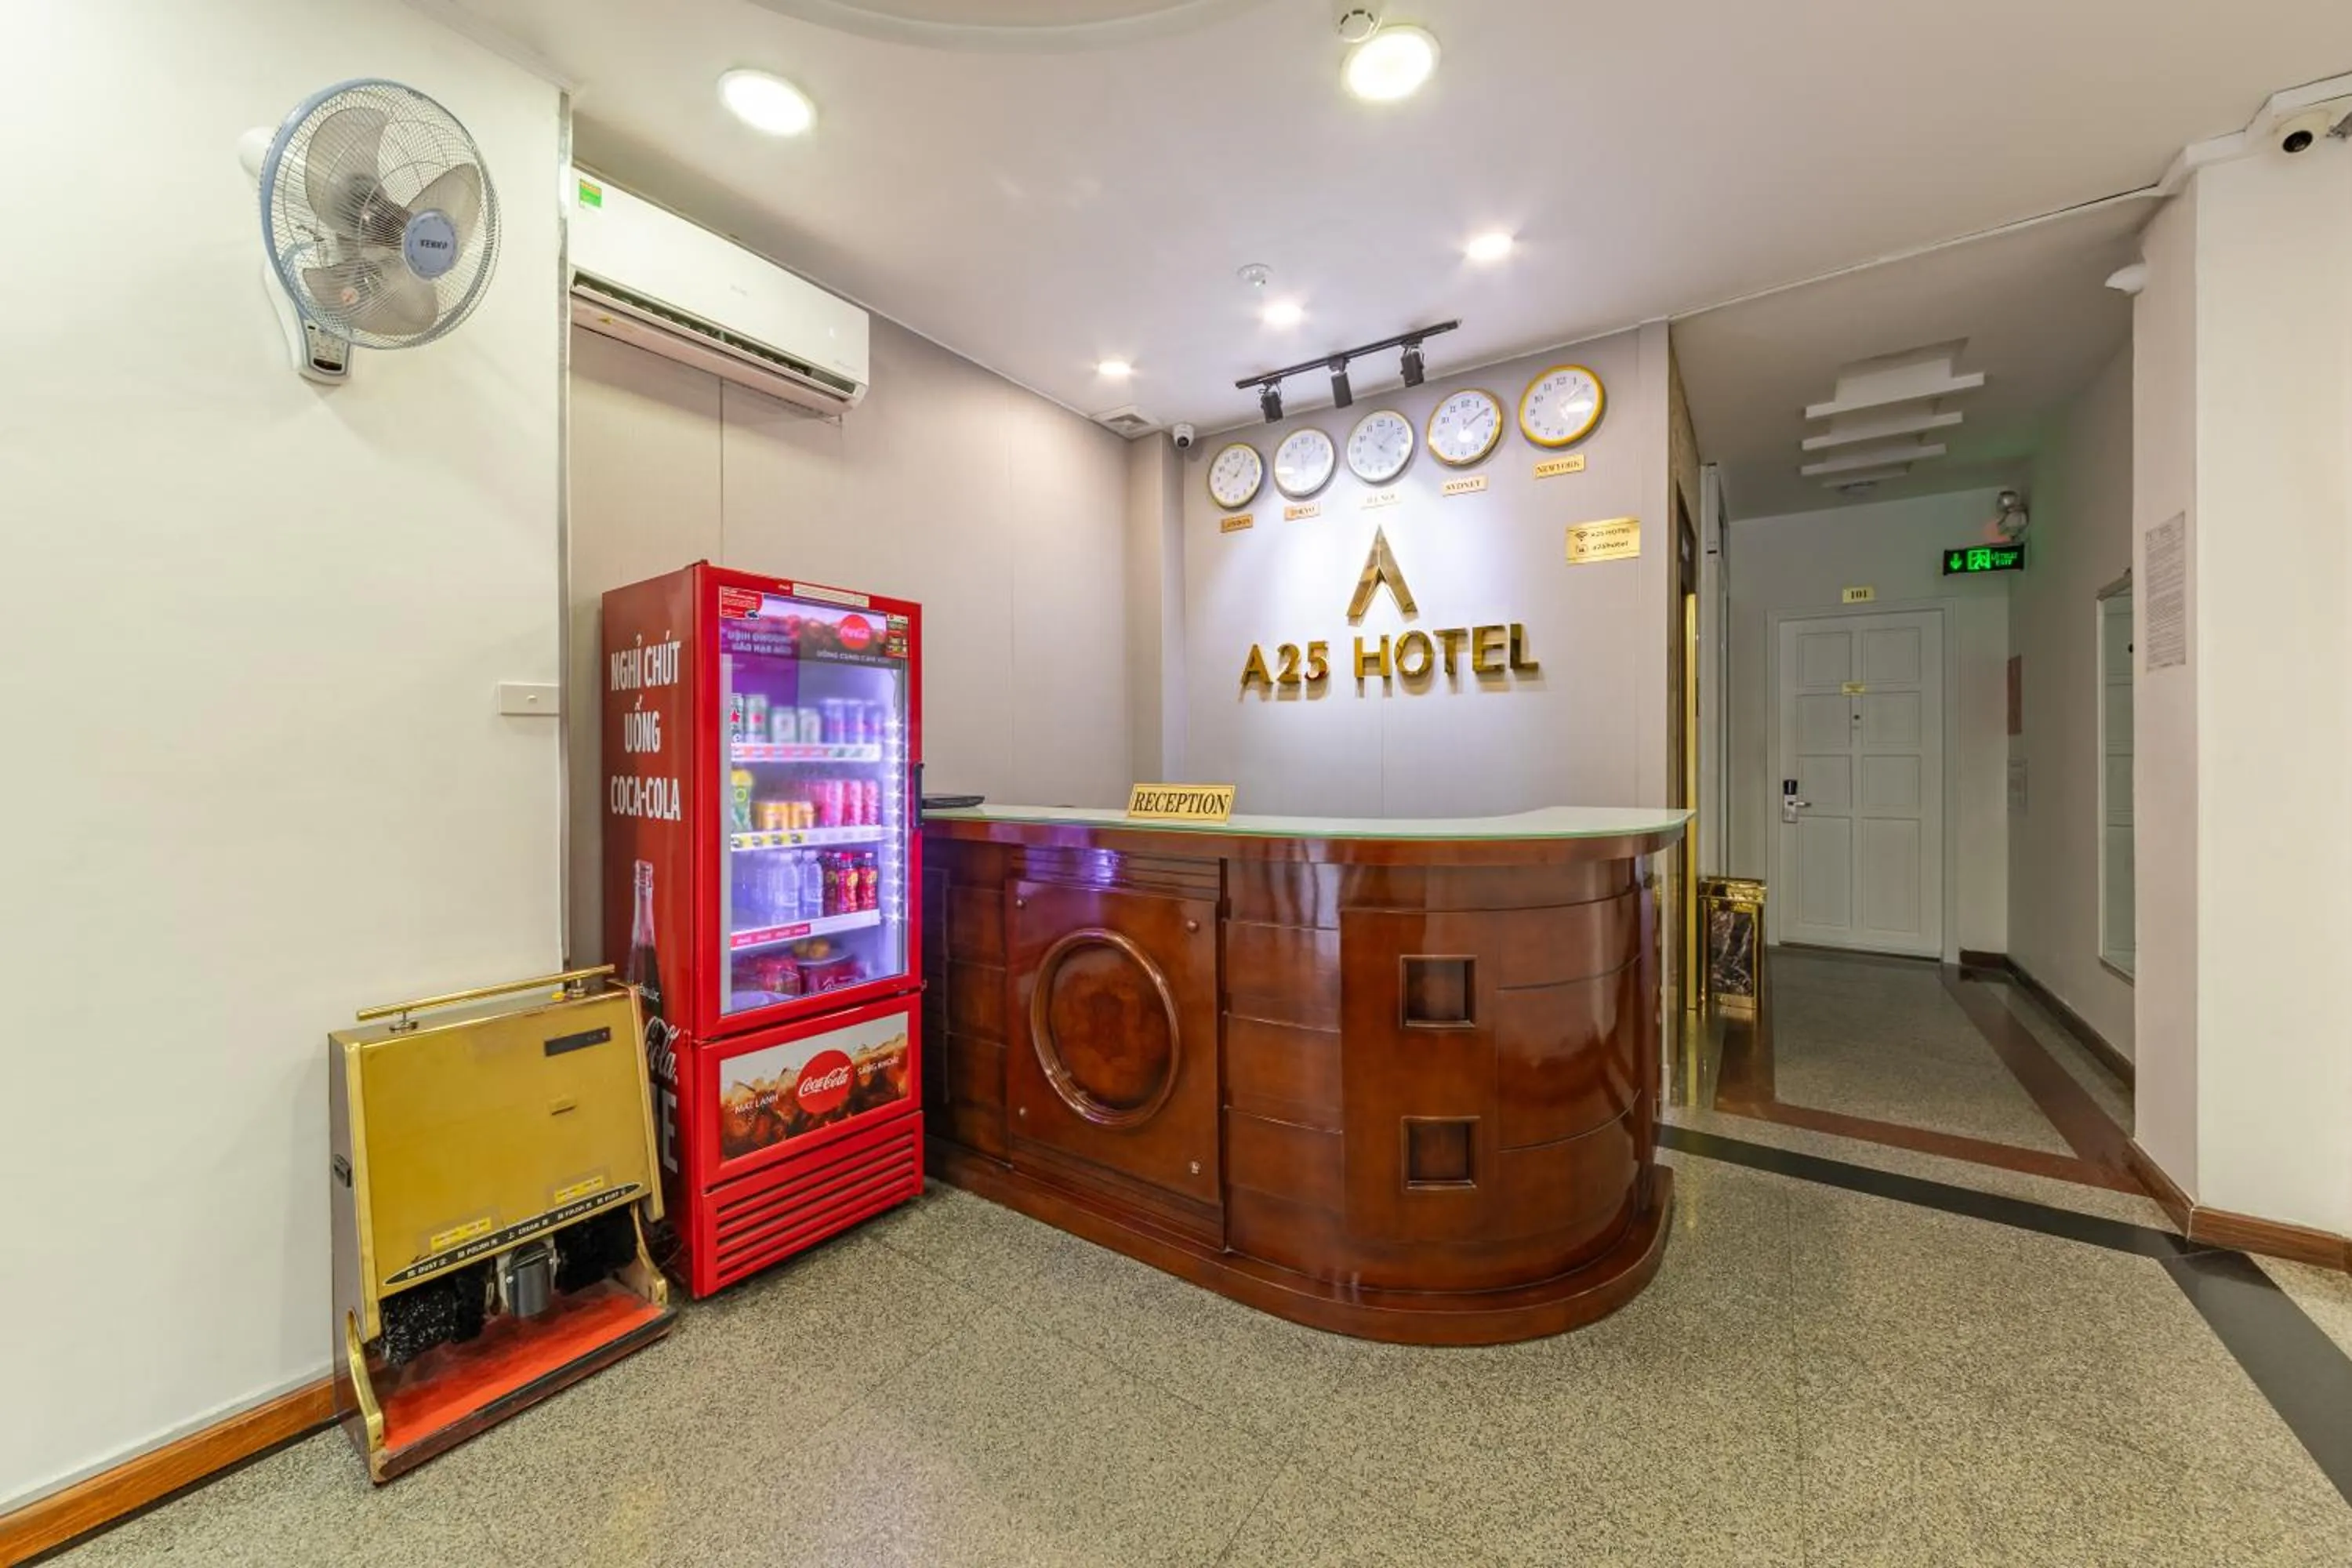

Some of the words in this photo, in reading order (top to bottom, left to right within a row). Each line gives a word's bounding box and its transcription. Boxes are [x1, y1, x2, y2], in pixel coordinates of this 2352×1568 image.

[1445, 479, 1481, 491] SYDNEY
[1851, 589, 1867, 600] 101
[611, 633, 643, 691] NGHỈ
[644, 630, 681, 688] CHÚT
[1241, 639, 1330, 687] A25
[1353, 623, 1541, 679] HOTEL
[625, 693, 662, 753] UỐNG
[610, 774, 681, 822] COCA-COLA
[1132, 790, 1229, 815] RECEPTION
[798, 1065, 851, 1098] Coca-Cola
